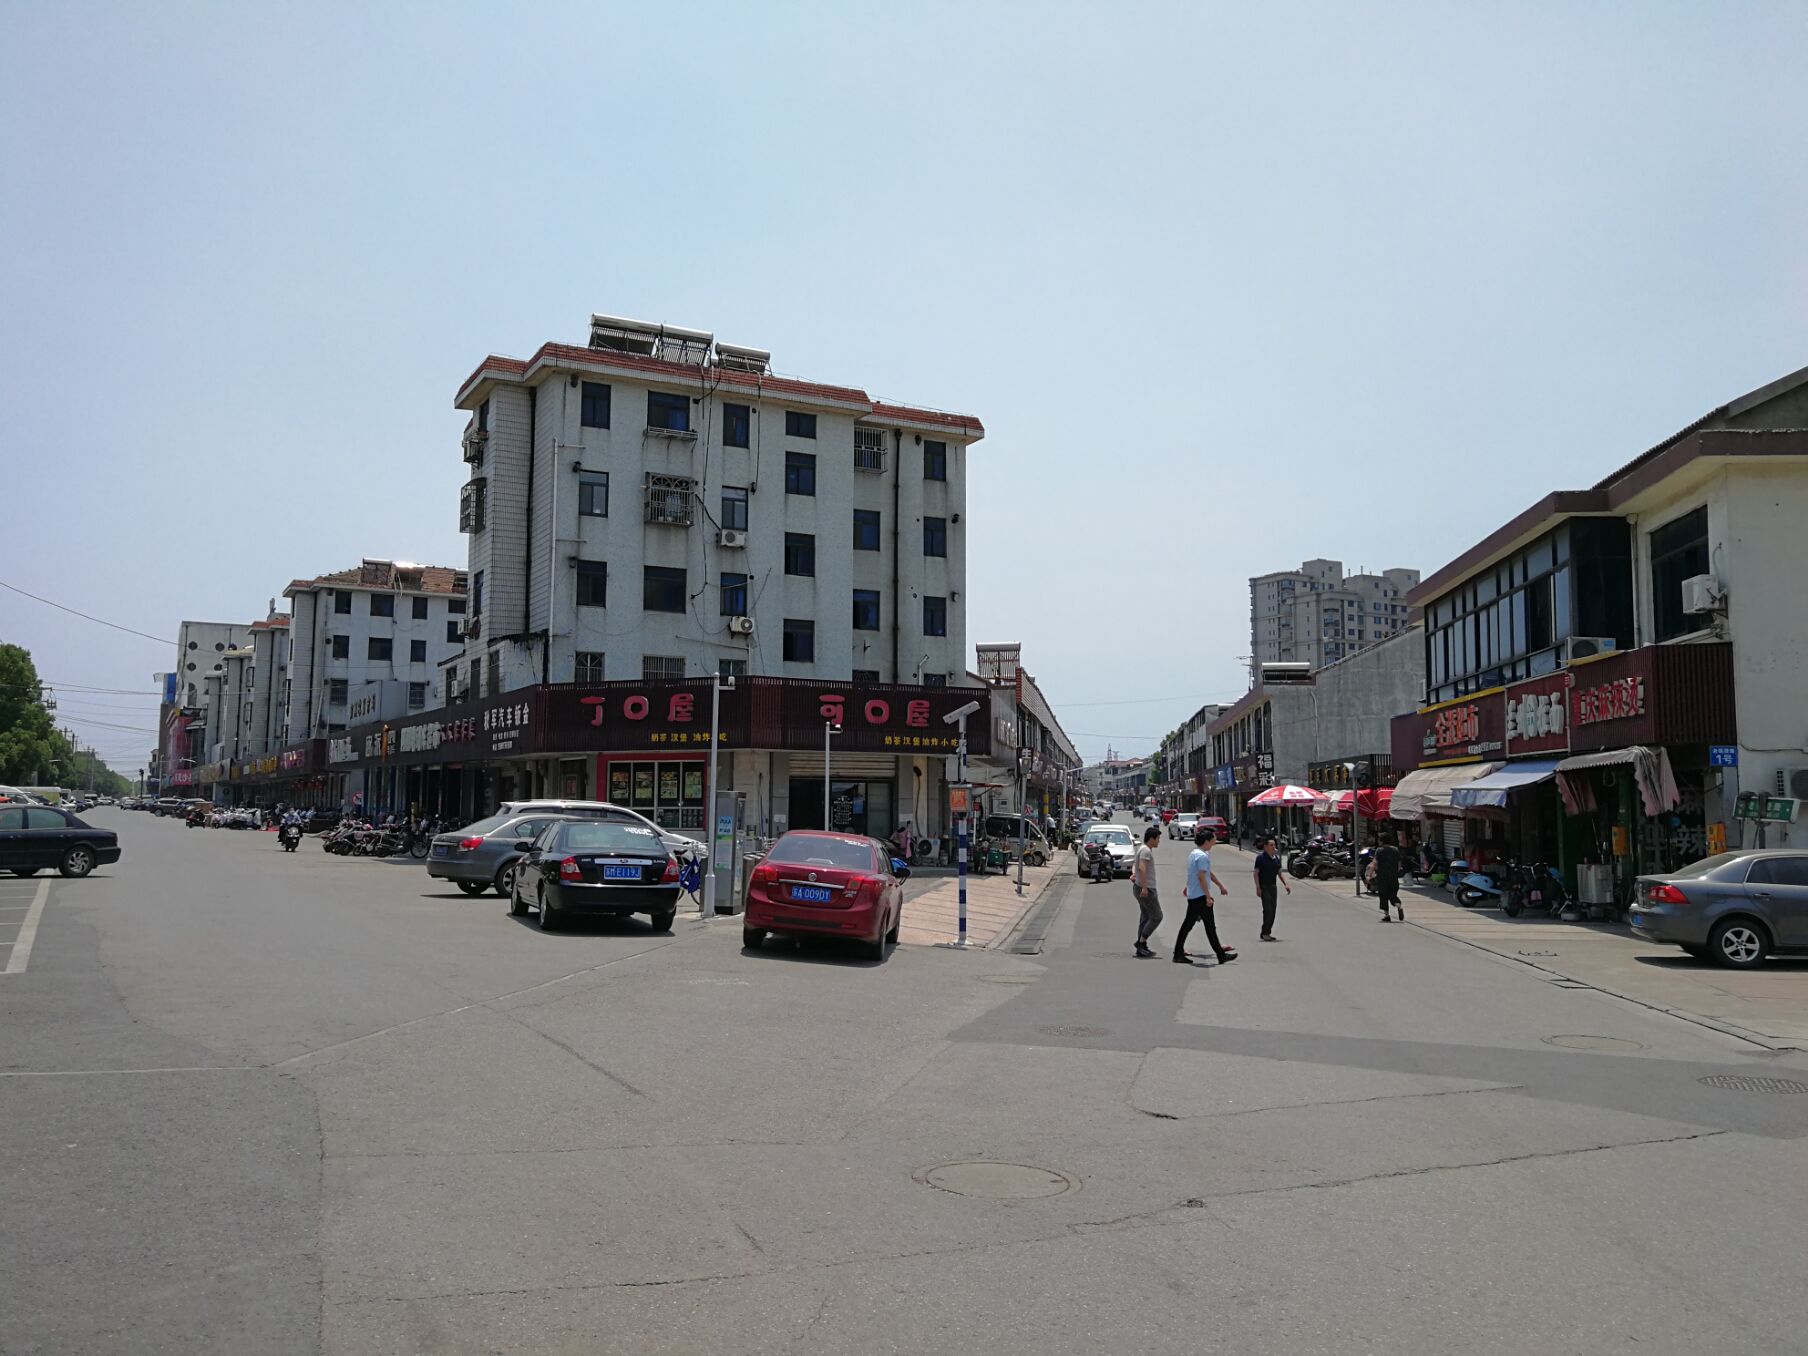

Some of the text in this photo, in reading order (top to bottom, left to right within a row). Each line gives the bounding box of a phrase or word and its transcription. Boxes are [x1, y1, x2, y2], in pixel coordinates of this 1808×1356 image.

[819, 694, 930, 727] 可口屋
[1257, 754, 1274, 786] 福彩
